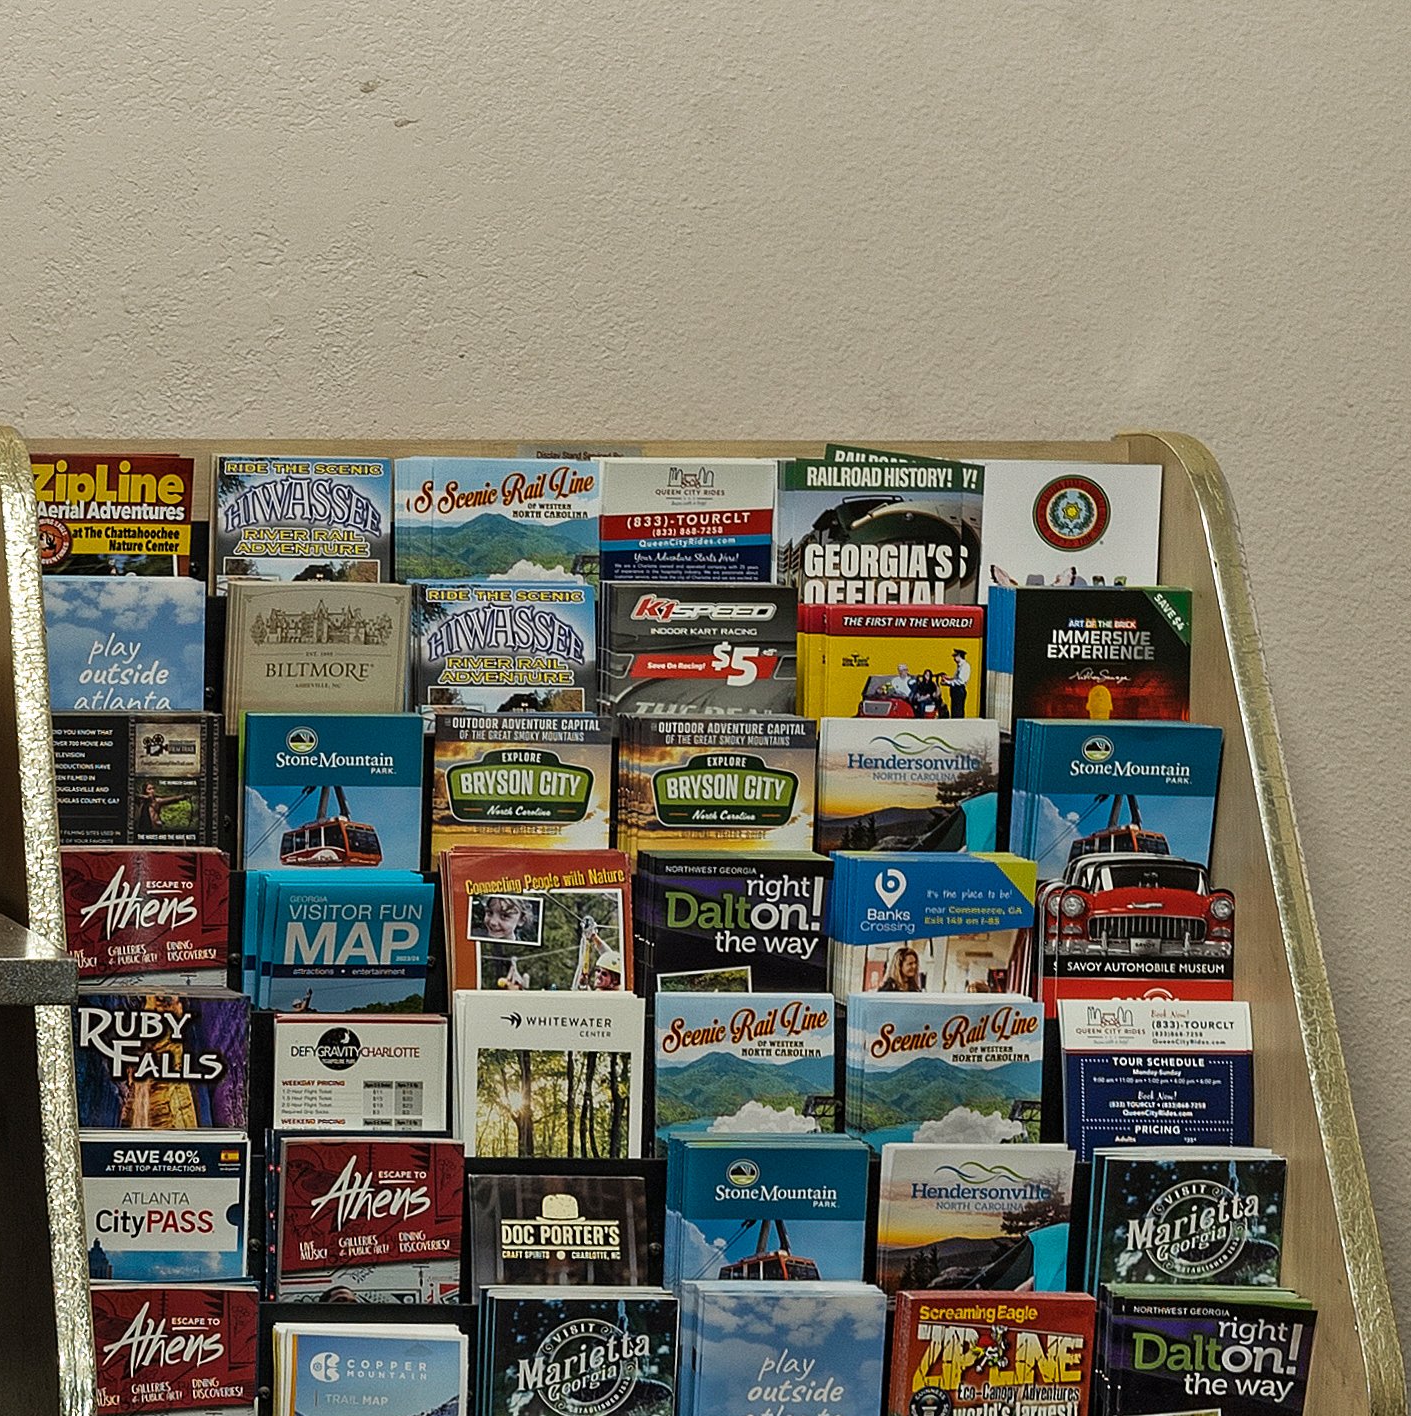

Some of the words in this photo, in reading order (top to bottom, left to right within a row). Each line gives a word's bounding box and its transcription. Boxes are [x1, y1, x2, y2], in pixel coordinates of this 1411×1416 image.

[225, 462, 268, 475] RIDE
[274, 462, 308, 475] THE
[314, 463, 383, 476] SCENIC
[806, 467, 882, 487] RAILROAD
[884, 468, 953, 488] HISTORY!
[31, 459, 184, 511] ZipLine
[437, 481, 497, 514] Scenic
[501, 474, 544, 506] Rail
[548, 466, 594, 499] Line
[38, 501, 85, 521] Aerial
[89, 501, 184, 520] Adventures
[224, 477, 381, 538] HIWASSEE
[627, 512, 750, 529] (833)-TOURCLT
[72, 528, 82, 538] at
[84, 527, 102, 538] The
[104, 527, 180, 541] Chattahoochee
[243, 529, 309, 542] RIVER
[313, 529, 364, 542] RAIL
[639, 537, 736, 548] QueenCityRides.com
[109, 541, 141, 552] Nature
[145, 541, 179, 552] Center
[234, 542, 370, 557] ADVENTURE
[804, 544, 953, 578] GEORGIA'S
[843, 617, 863, 627] THE
[866, 617, 892, 627] FIRST
[896, 618, 906, 627] IN
[909, 618, 929, 628] THE
[931, 618, 973, 628] WORLD!
[1052, 630, 1151, 646] IMMERSIVE
[89, 633, 140, 664] play
[1047, 644, 1155, 661] EXPERIENCE
[79, 661, 170, 685] outside
[74, 688, 170, 711] atlanta
[452, 718, 500, 730] OUTDOOR
[502, 718, 559, 731] ADVENTURE
[561, 719, 600, 731] CAPITAL
[501, 752, 542, 763] EXPLORE
[847, 753, 980, 770] Hendersonville
[460, 771, 532, 796] BRYSON
[539, 772, 582, 797] CITY
[872, 772, 906, 781] NORTH
[911, 772, 956, 781] CAROLINA
[666, 866, 716, 874] NORTHWEST
[719, 866, 757, 874] GEORGIA
[146, 881, 179, 889] ESCAPE
[181, 881, 193, 889] TO
[465, 877, 522, 895] Connecting
[524, 874, 559, 891] People
[562, 872, 586, 886] with
[589, 869, 625, 884] Nature
[746, 875, 810, 902] right
[80, 865, 198, 941] Athens
[289, 904, 371, 919] VISITOR
[379, 904, 423, 920] FUN
[867, 908, 911, 921] Banks
[860, 920, 915, 935] Crossing
[283, 922, 420, 965] MAP
[715, 931, 756, 953] the
[763, 935, 819, 960] way
[1067, 962, 1101, 973] SAVOY
[1103, 962, 1175, 973] AUTOMOBILE
[1179, 962, 1225, 974] MUSEUM
[79, 1008, 191, 1048] RUBY
[526, 1017, 612, 1028] WHITEWATER
[112, 1039, 223, 1080] FALLS
[1112, 1057, 1143, 1067] TOUR
[1147, 1058, 1205, 1067] SCHEDULE
[1135, 1125, 1180, 1134] PRICING
[113, 1150, 160, 1164] SAVE
[163, 1150, 200, 1164] 40%
[152, 1165, 207, 1173] ATTRACTIONS
[122, 1192, 190, 1205] ATLANTA
[310, 1155, 431, 1231] Athens
[1165, 1185, 1206, 1204] VISIT
[96, 1209, 214, 1238] CityPASS
[1125, 1195, 1259, 1250] Marietta
[501, 1225, 535, 1245] DOC
[540, 1225, 620, 1245] PORTER'S
[1157, 1225, 1226, 1261] Georgia
[919, 1305, 996, 1322] Screaming
[997, 1305, 1038, 1323] Eagle
[346, 1359, 427, 1371] COPPER
[346, 1371, 427, 1381] MOUNTAIN
[326, 1394, 359, 1405] TRAIL
[362, 1395, 389, 1406] MAP
[958, 1383, 1018, 1403] Eco-Canopy
[1023, 1385, 1079, 1400] Adventures
